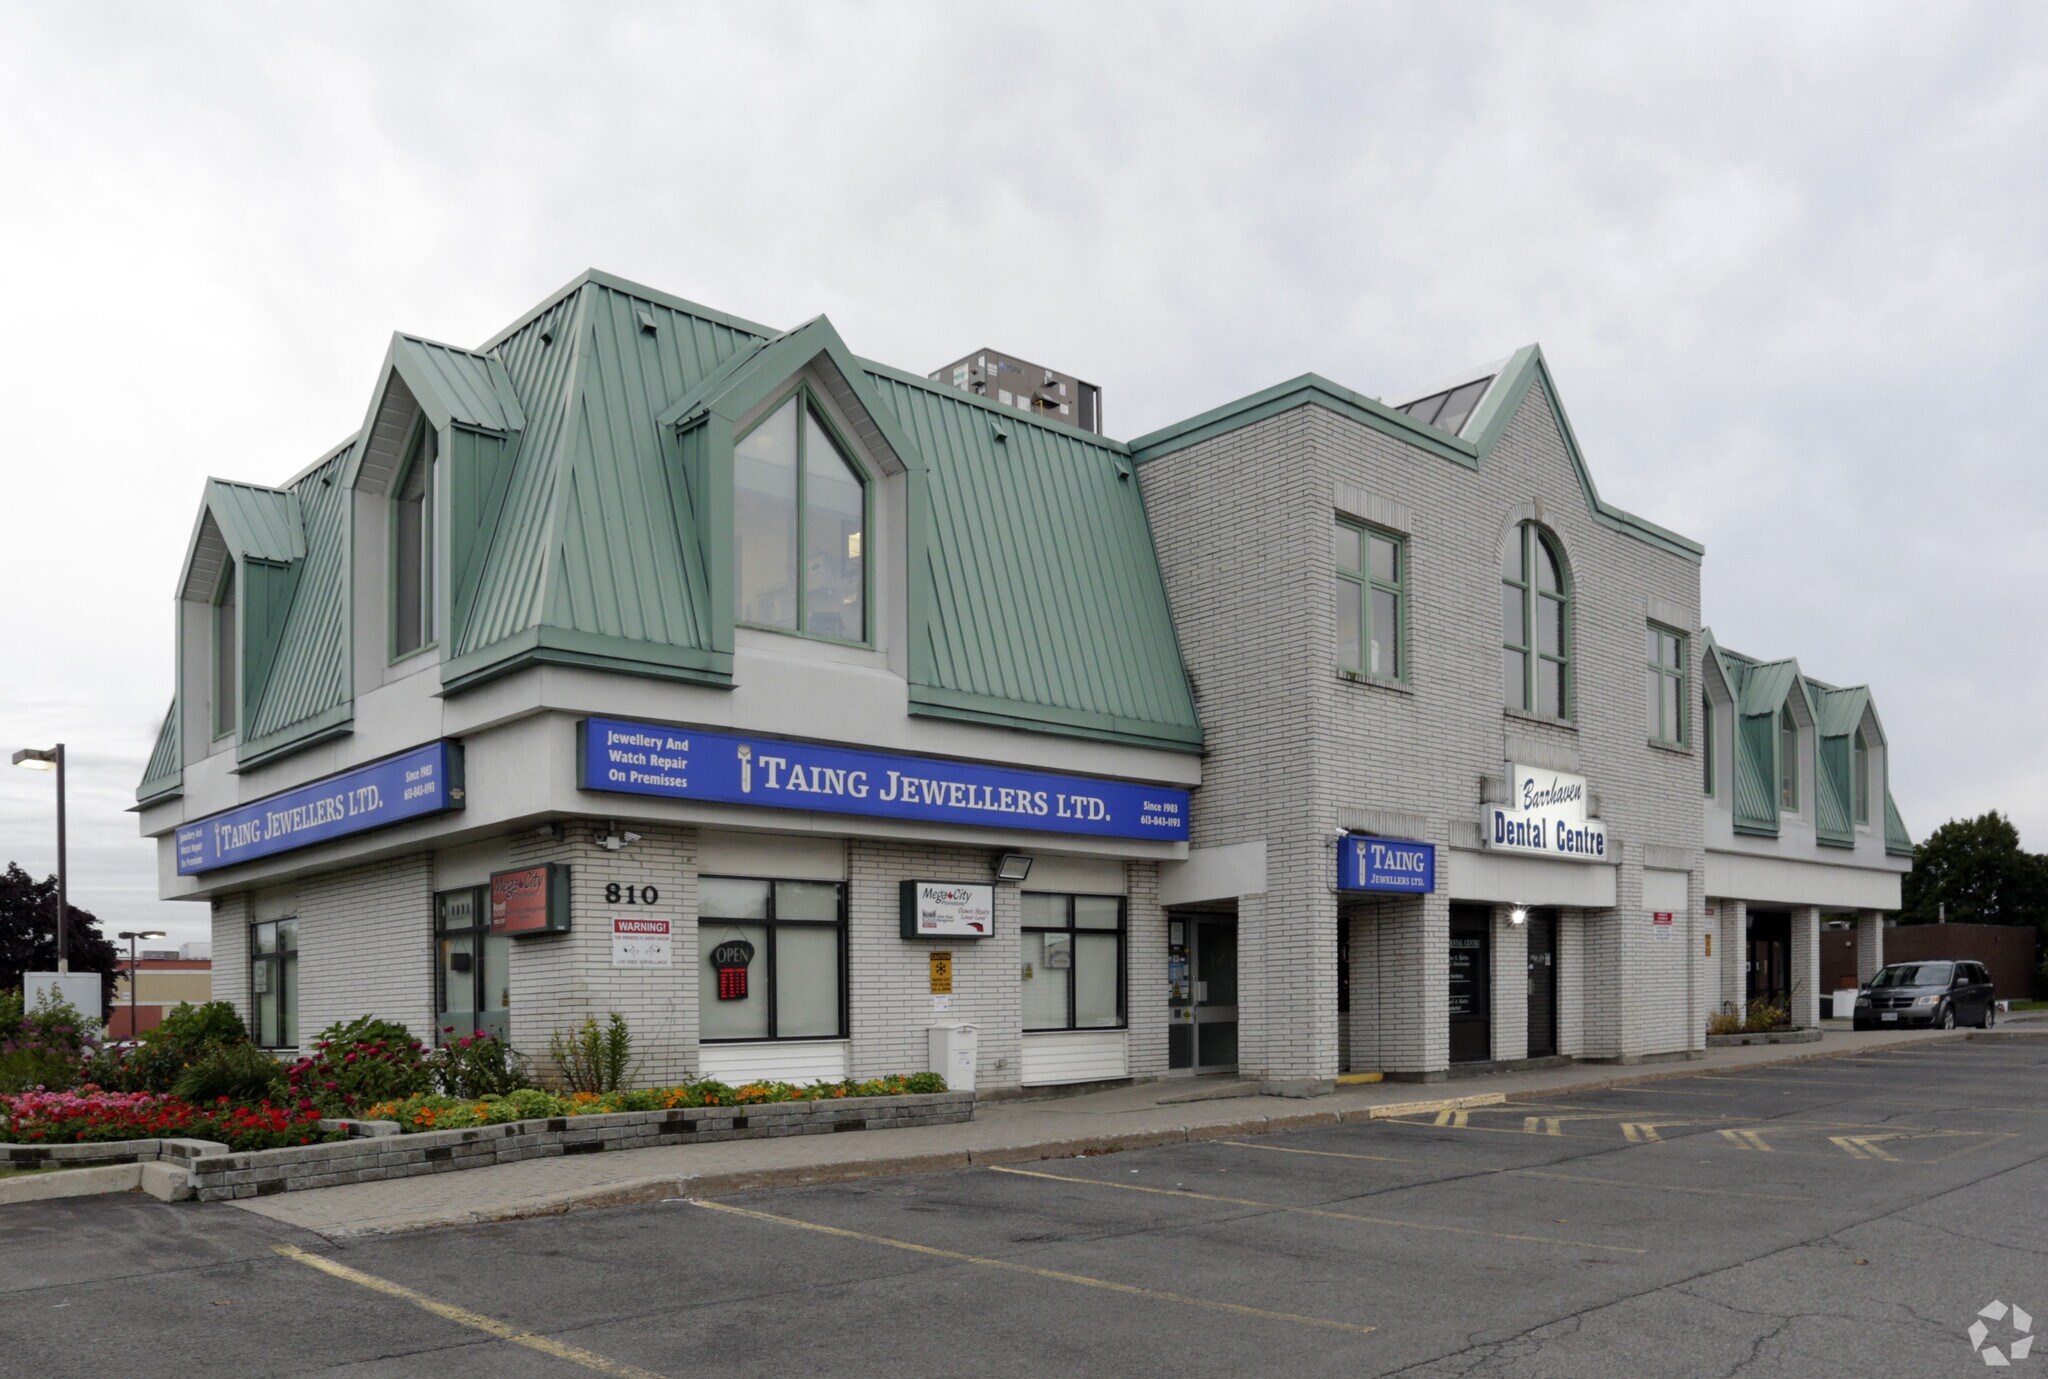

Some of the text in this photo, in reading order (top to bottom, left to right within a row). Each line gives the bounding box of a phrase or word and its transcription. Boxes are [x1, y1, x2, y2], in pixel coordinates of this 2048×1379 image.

[607, 730, 690, 752] Jewellery And
[608, 750, 689, 771] Watch Repair
[405, 770, 420, 783] Since
[608, 768, 688, 789] On Premisses
[758, 755, 1111, 822] TAING JEWELLERS LTD.
[1522, 775, 1583, 811] Barrhaven
[1143, 800, 1179, 814] Since 1983
[221, 784, 384, 852] TAING JEWELLERS LTD.
[1140, 814, 1181, 828] 613-843-1193
[1494, 810, 1604, 856] Dental Centre
[1370, 844, 1425, 873] TAING
[493, 871, 545, 900] Mega City
[1370, 873, 1425, 887] JEWELLERS LTD.
[605, 882, 659, 906] 810
[922, 887, 973, 904] Mega City
[618, 921, 667, 933] WARNING!
[715, 946, 750, 963] OPEN
